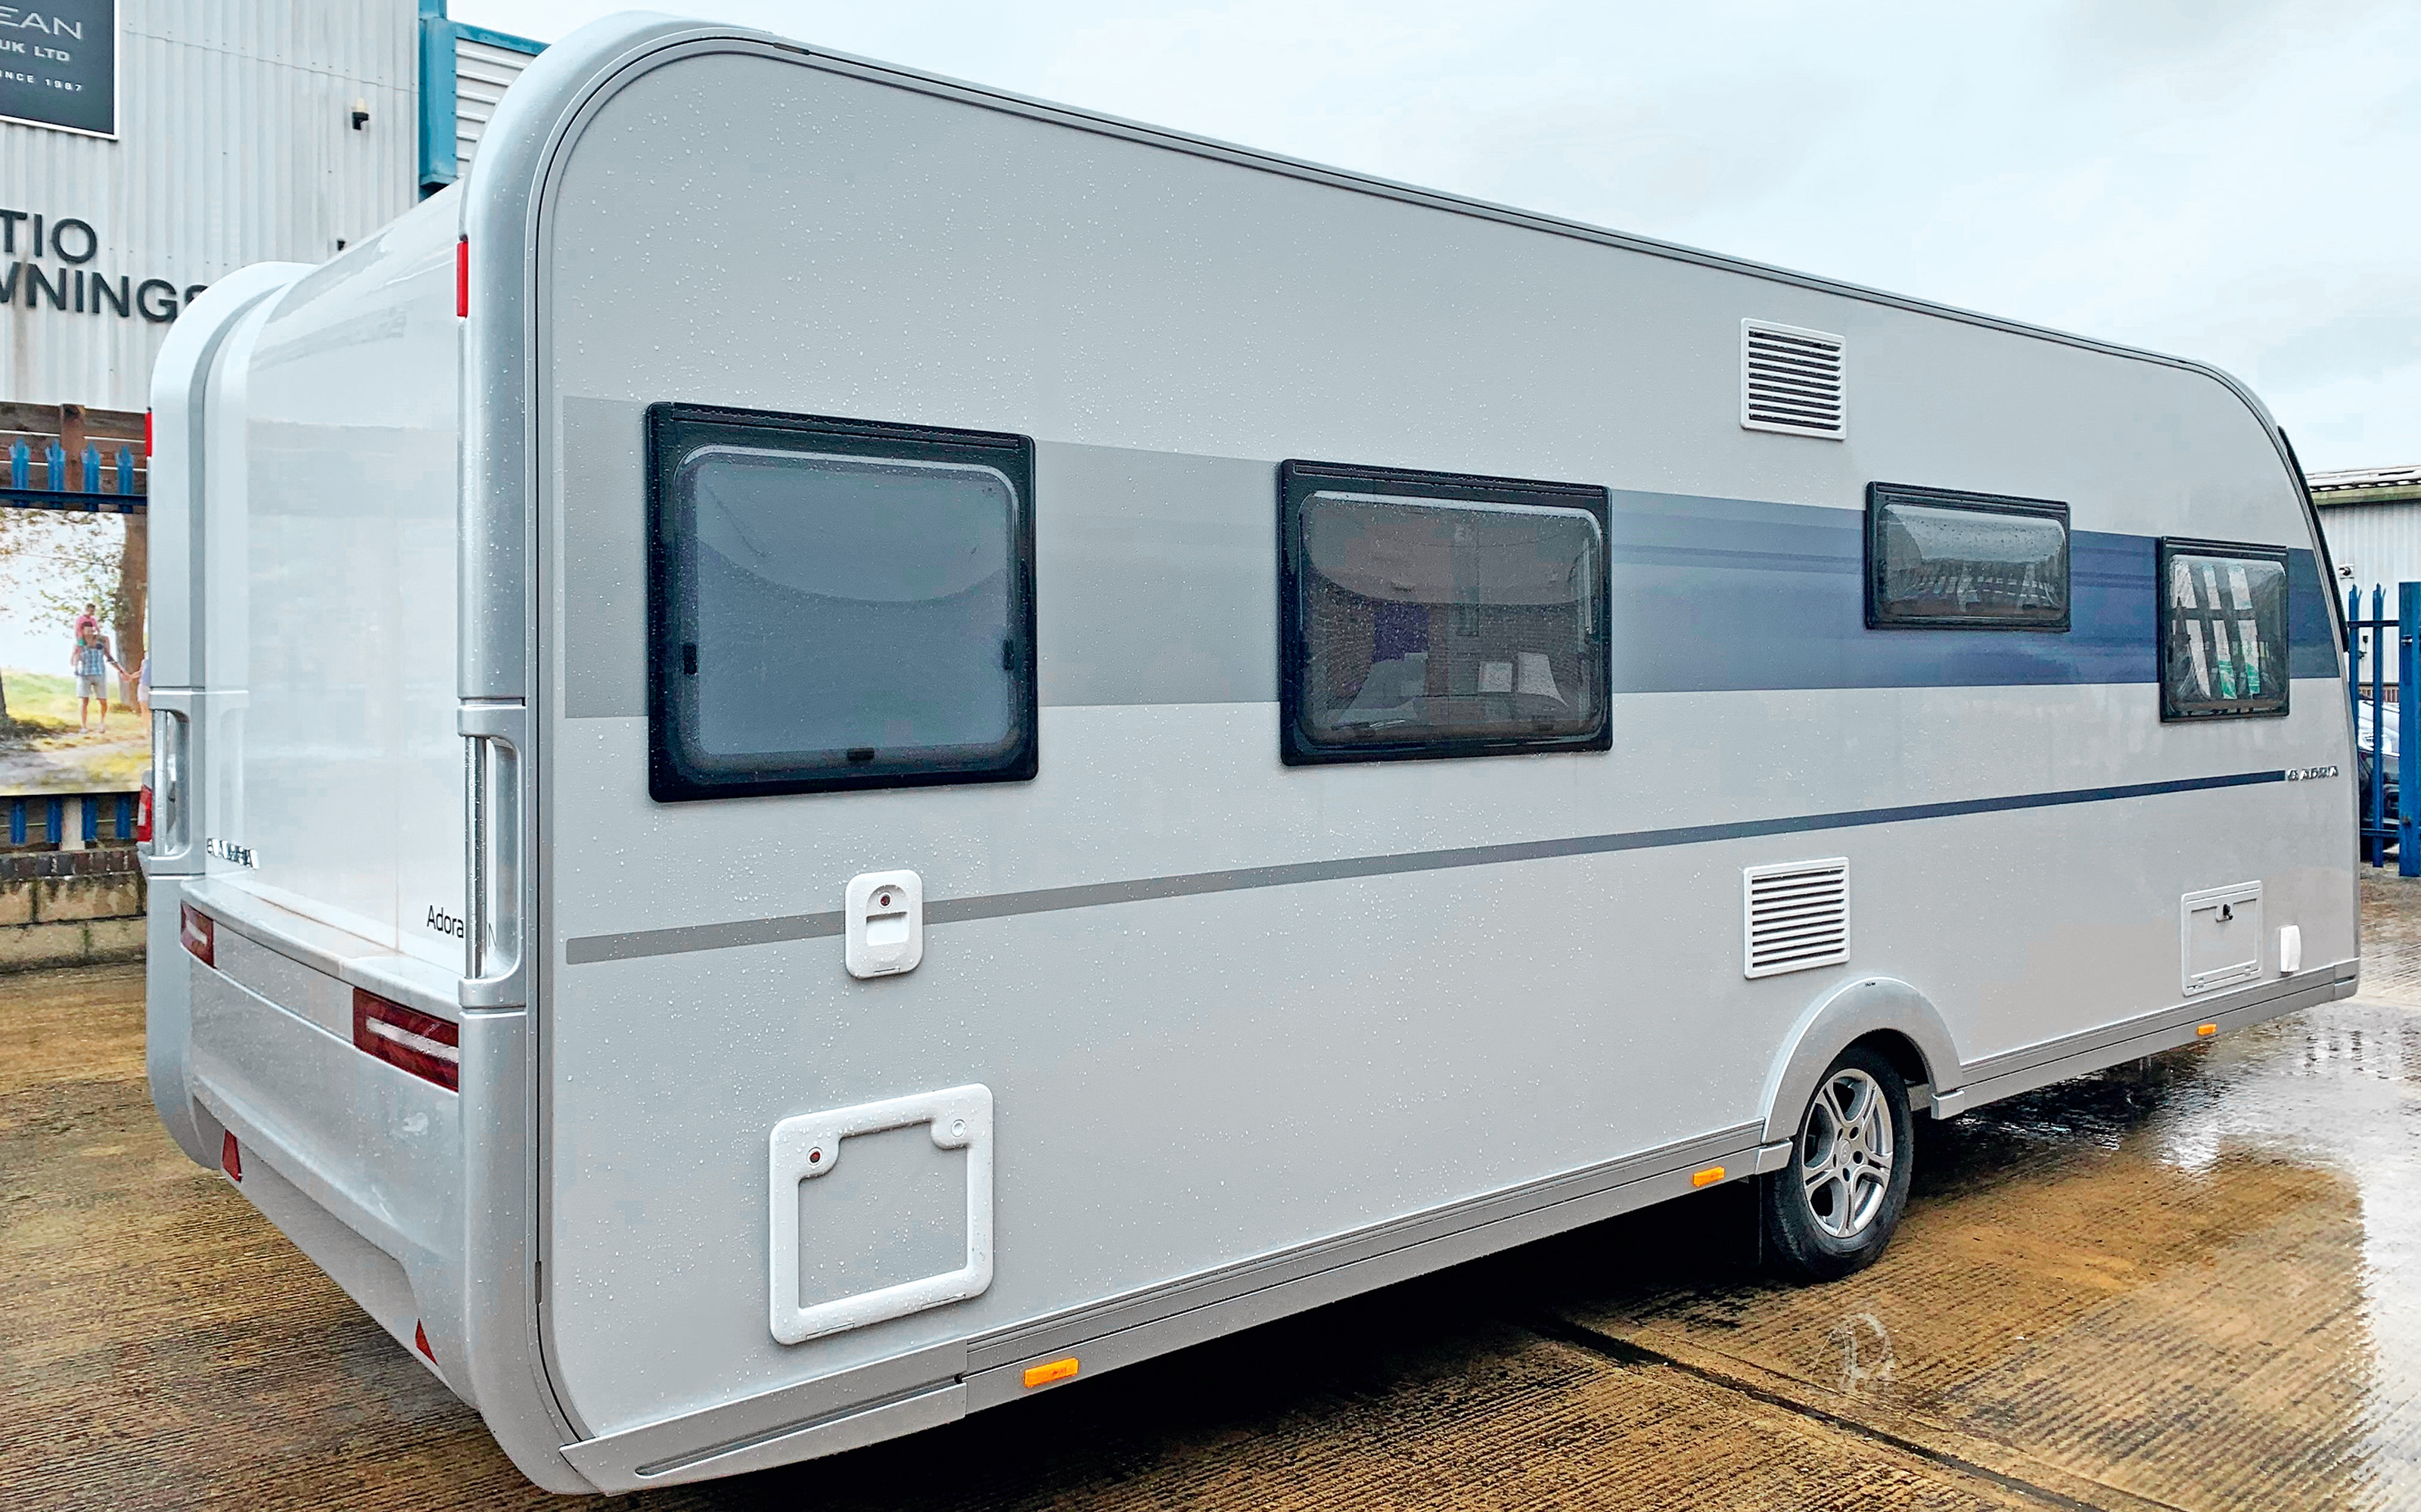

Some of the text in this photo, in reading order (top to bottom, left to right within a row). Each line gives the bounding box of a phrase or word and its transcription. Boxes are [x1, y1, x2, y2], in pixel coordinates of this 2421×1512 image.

[34, 45, 70, 61] LTD
[0, 209, 98, 264] TIO
[426, 905, 464, 939] Adora
